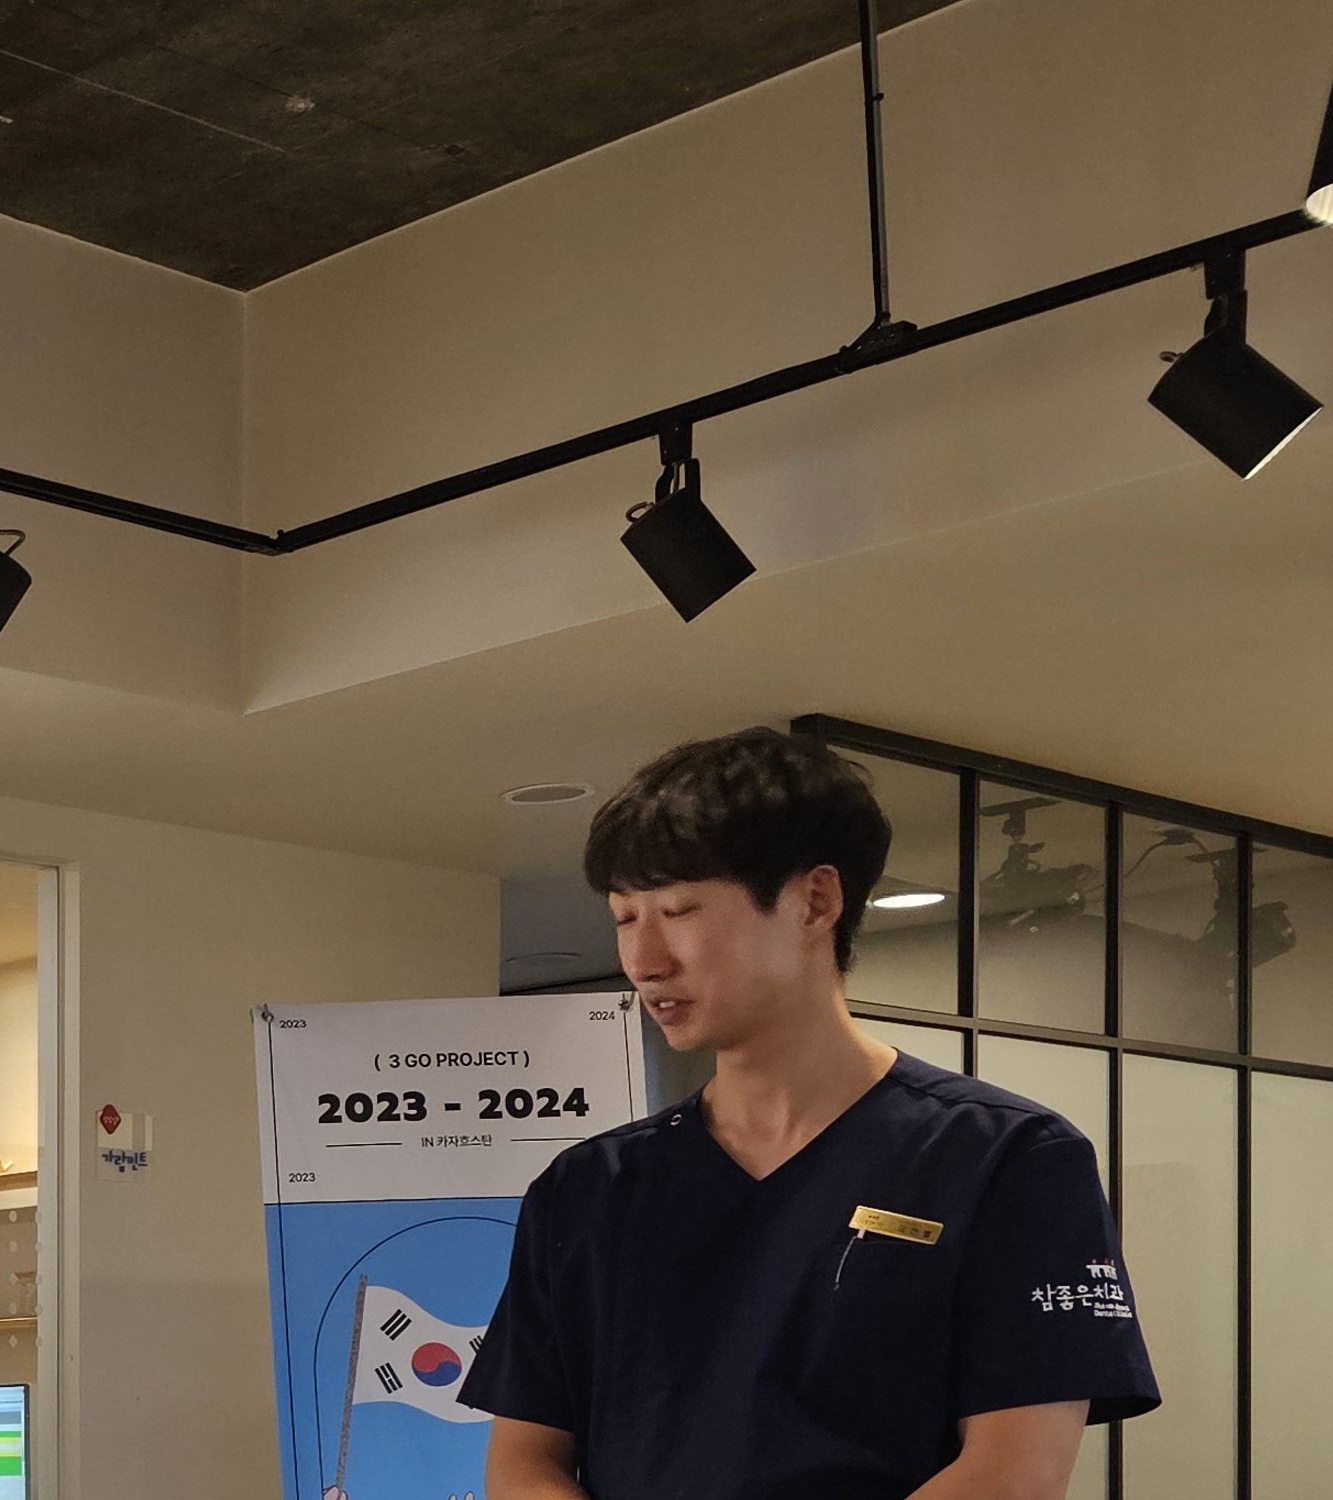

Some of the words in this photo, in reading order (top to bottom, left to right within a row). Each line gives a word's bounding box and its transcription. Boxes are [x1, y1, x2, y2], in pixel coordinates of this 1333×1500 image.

[588, 1010, 616, 1022] 2024
[279, 1018, 308, 1030] 2023
[404, 1053, 433, 1069] GO
[436, 1050, 520, 1068] PROJECT
[317, 1091, 428, 1125] 2023
[478, 1087, 590, 1121] 2024
[420, 1137, 434, 1149] IN
[436, 1134, 494, 1149] 카자흐스탄
[288, 1172, 317, 1184] 2023
[1031, 1282, 1124, 1312] 참좋은치과
